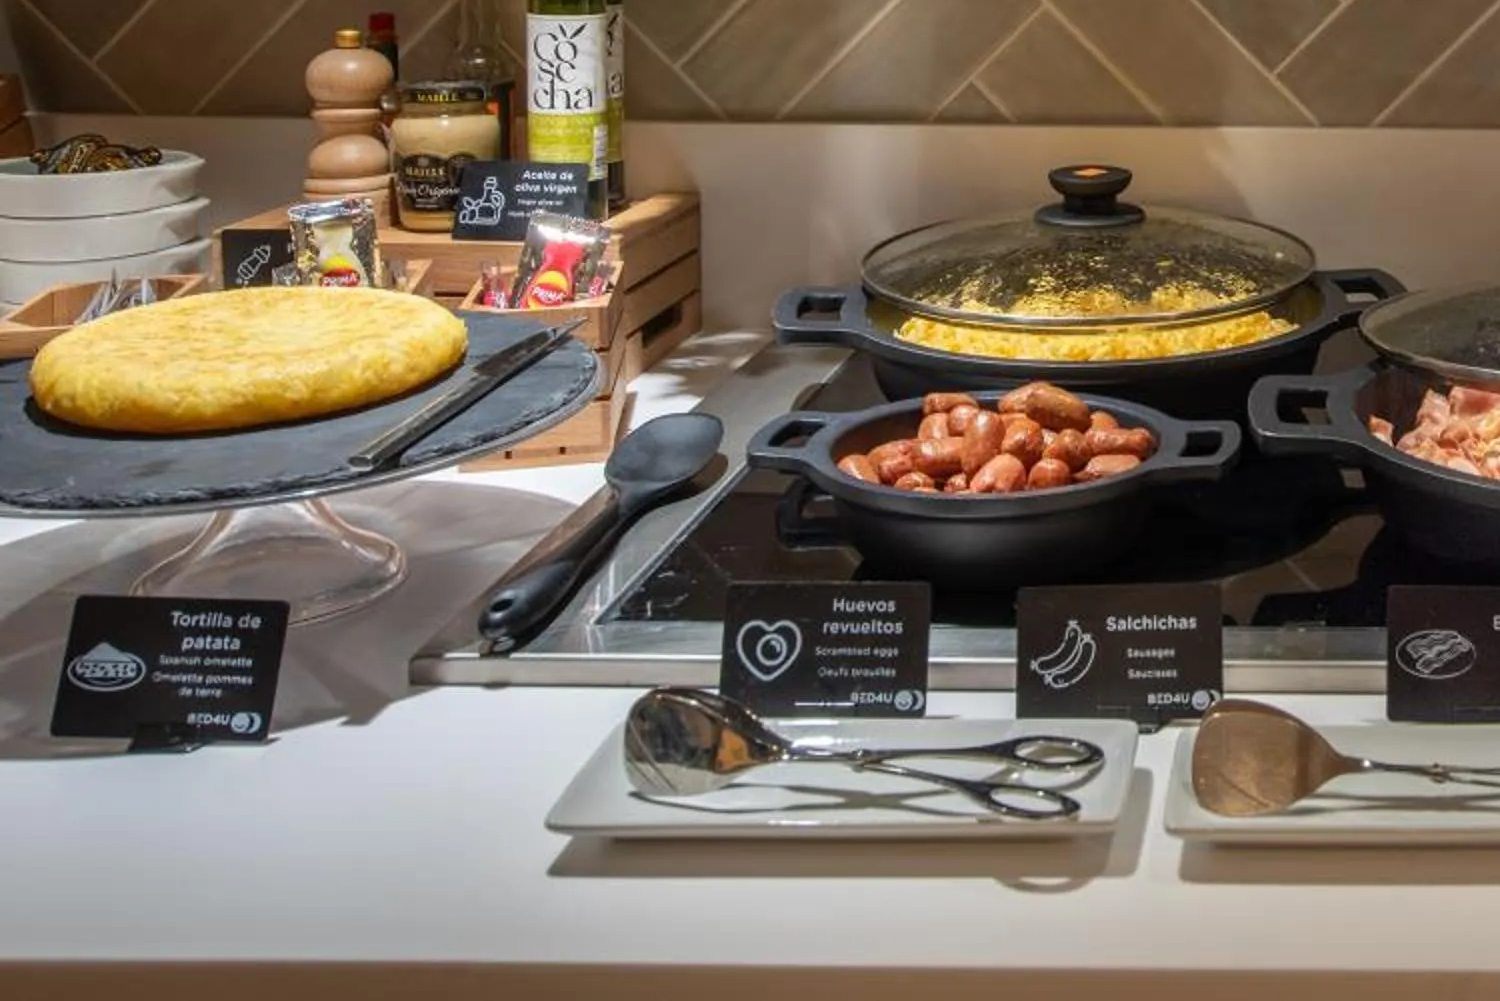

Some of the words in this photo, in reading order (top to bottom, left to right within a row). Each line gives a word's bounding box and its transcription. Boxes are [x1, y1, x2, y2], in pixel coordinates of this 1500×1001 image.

[523, 170, 557, 180] Aceite
[560, 170, 574, 180] de
[832, 598, 897, 613] Huevos
[171, 611, 233, 629] Tortilla
[238, 612, 262, 629] de
[822, 618, 904, 634] revueltos
[1105, 615, 1198, 632] Salchichas
[181, 634, 242, 652] patata
[815, 646, 871, 657] Scrambled
[873, 647, 899, 658] eggs
